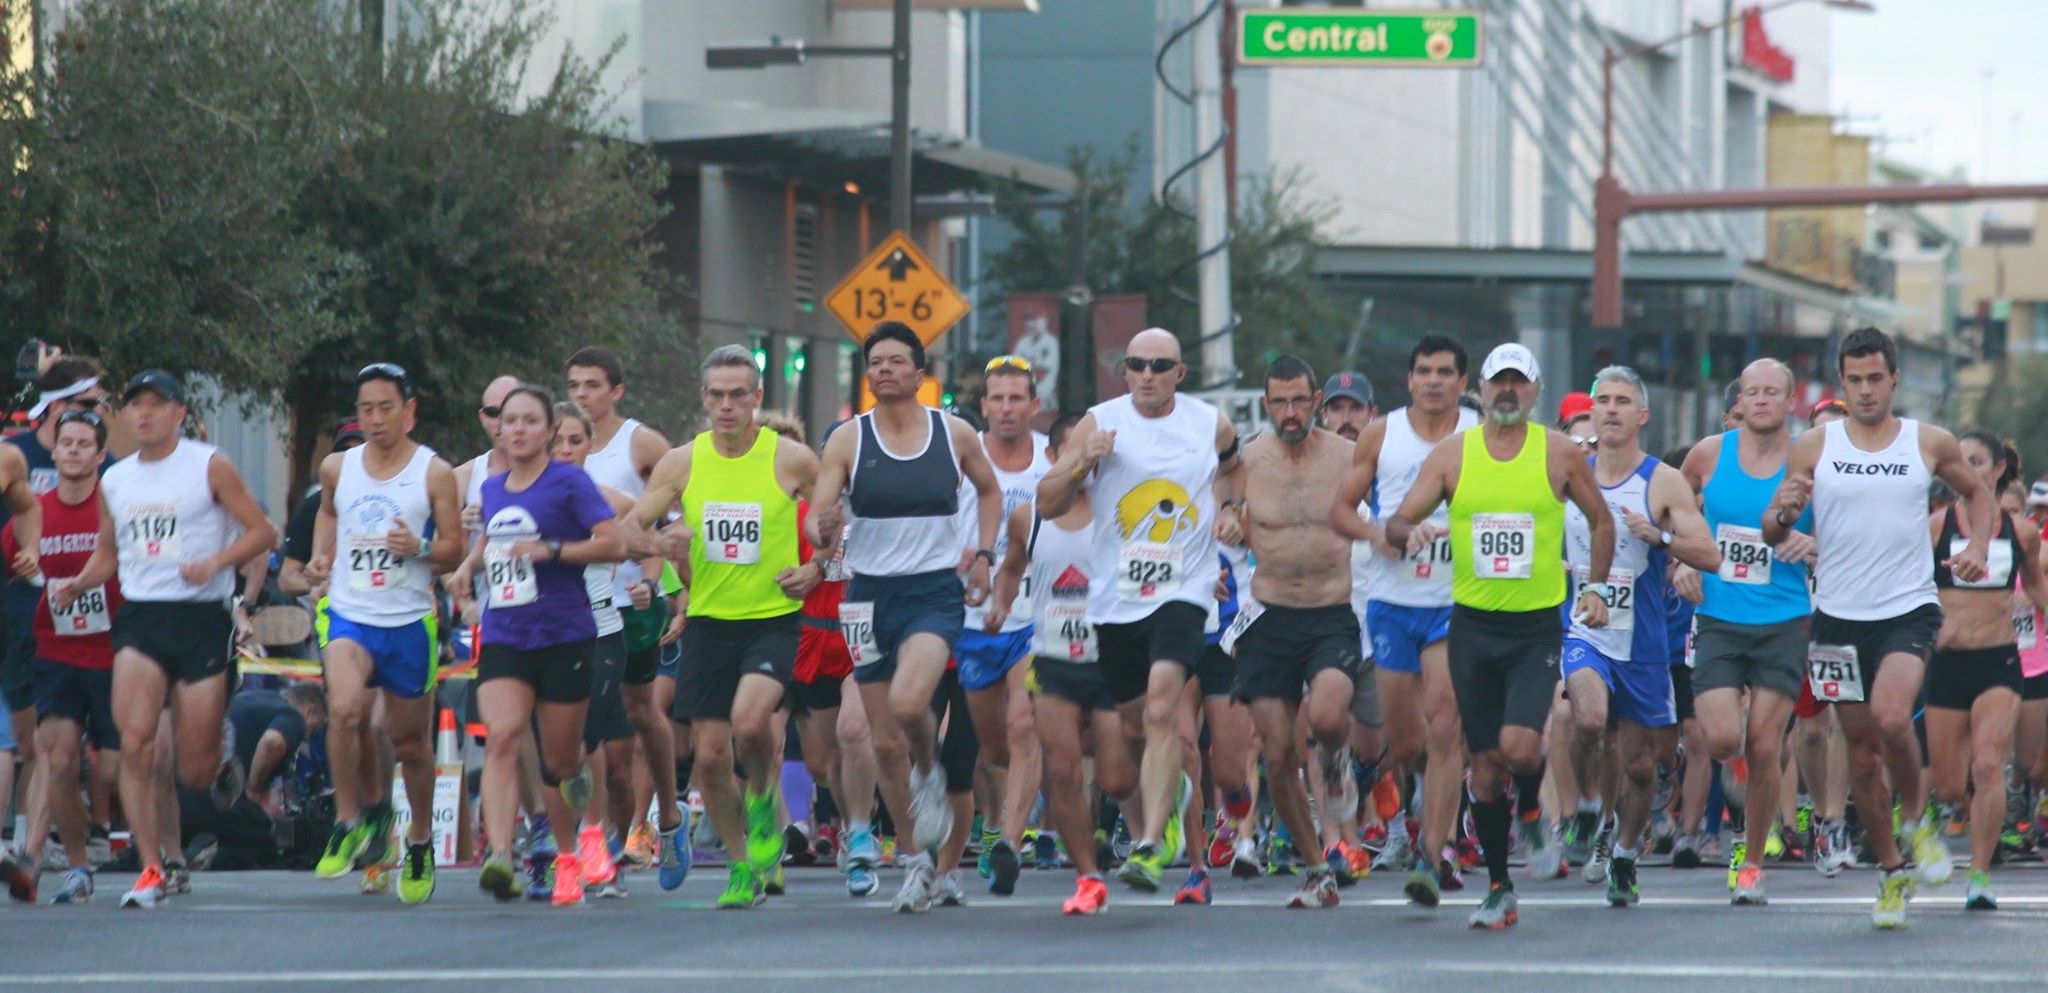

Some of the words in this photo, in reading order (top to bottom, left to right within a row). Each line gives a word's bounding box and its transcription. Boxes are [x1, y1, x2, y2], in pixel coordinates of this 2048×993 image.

[1263, 20, 1387, 53] Central
[1832, 460, 1909, 476] VELOVIE
[704, 519, 759, 543] 1046
[1480, 531, 1525, 555] 969
[1718, 540, 1769, 567] 1934
[1128, 559, 1172, 583] 823
